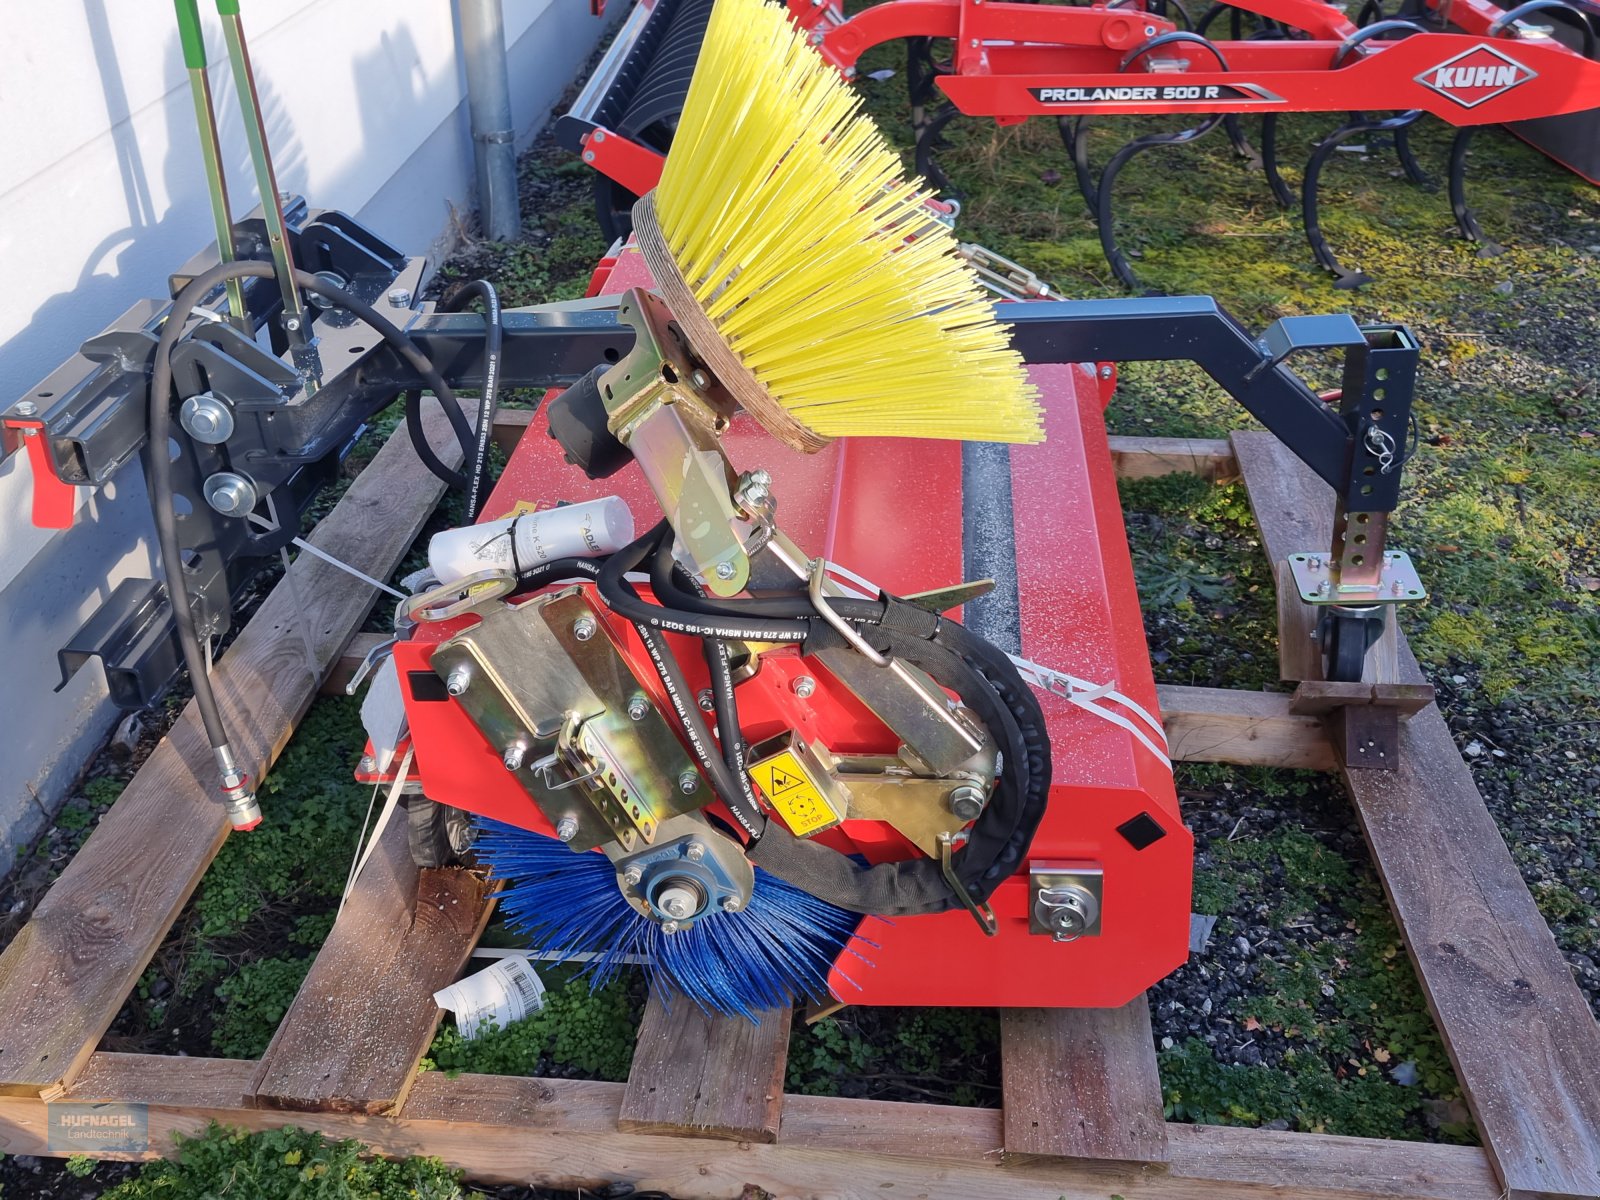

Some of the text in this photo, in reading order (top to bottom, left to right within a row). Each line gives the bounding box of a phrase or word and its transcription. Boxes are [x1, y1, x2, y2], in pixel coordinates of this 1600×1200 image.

[1435, 66, 1517, 88] KUHN
[1039, 86, 1219, 101] PROLANDER 500 R
[484, 400, 491, 410] WP
[484, 410, 490, 418] 12
[475, 464, 482, 474] HD
[468, 475, 480, 518] HANSA-FLEX
[536, 545, 547, 559] 520
[662, 620, 685, 631] 3Q21
[685, 624, 713, 635] IC-195
[716, 628, 741, 637] MSHA
[743, 630, 761, 638] BAR
[763, 631, 777, 639] 275
[718, 643, 734, 699] HANSA-FLEX
[638, 624, 707, 760] 2SN 12 WP 275 BAR MSHA IC-195 3Q21
[801, 814, 822, 827] STOP
